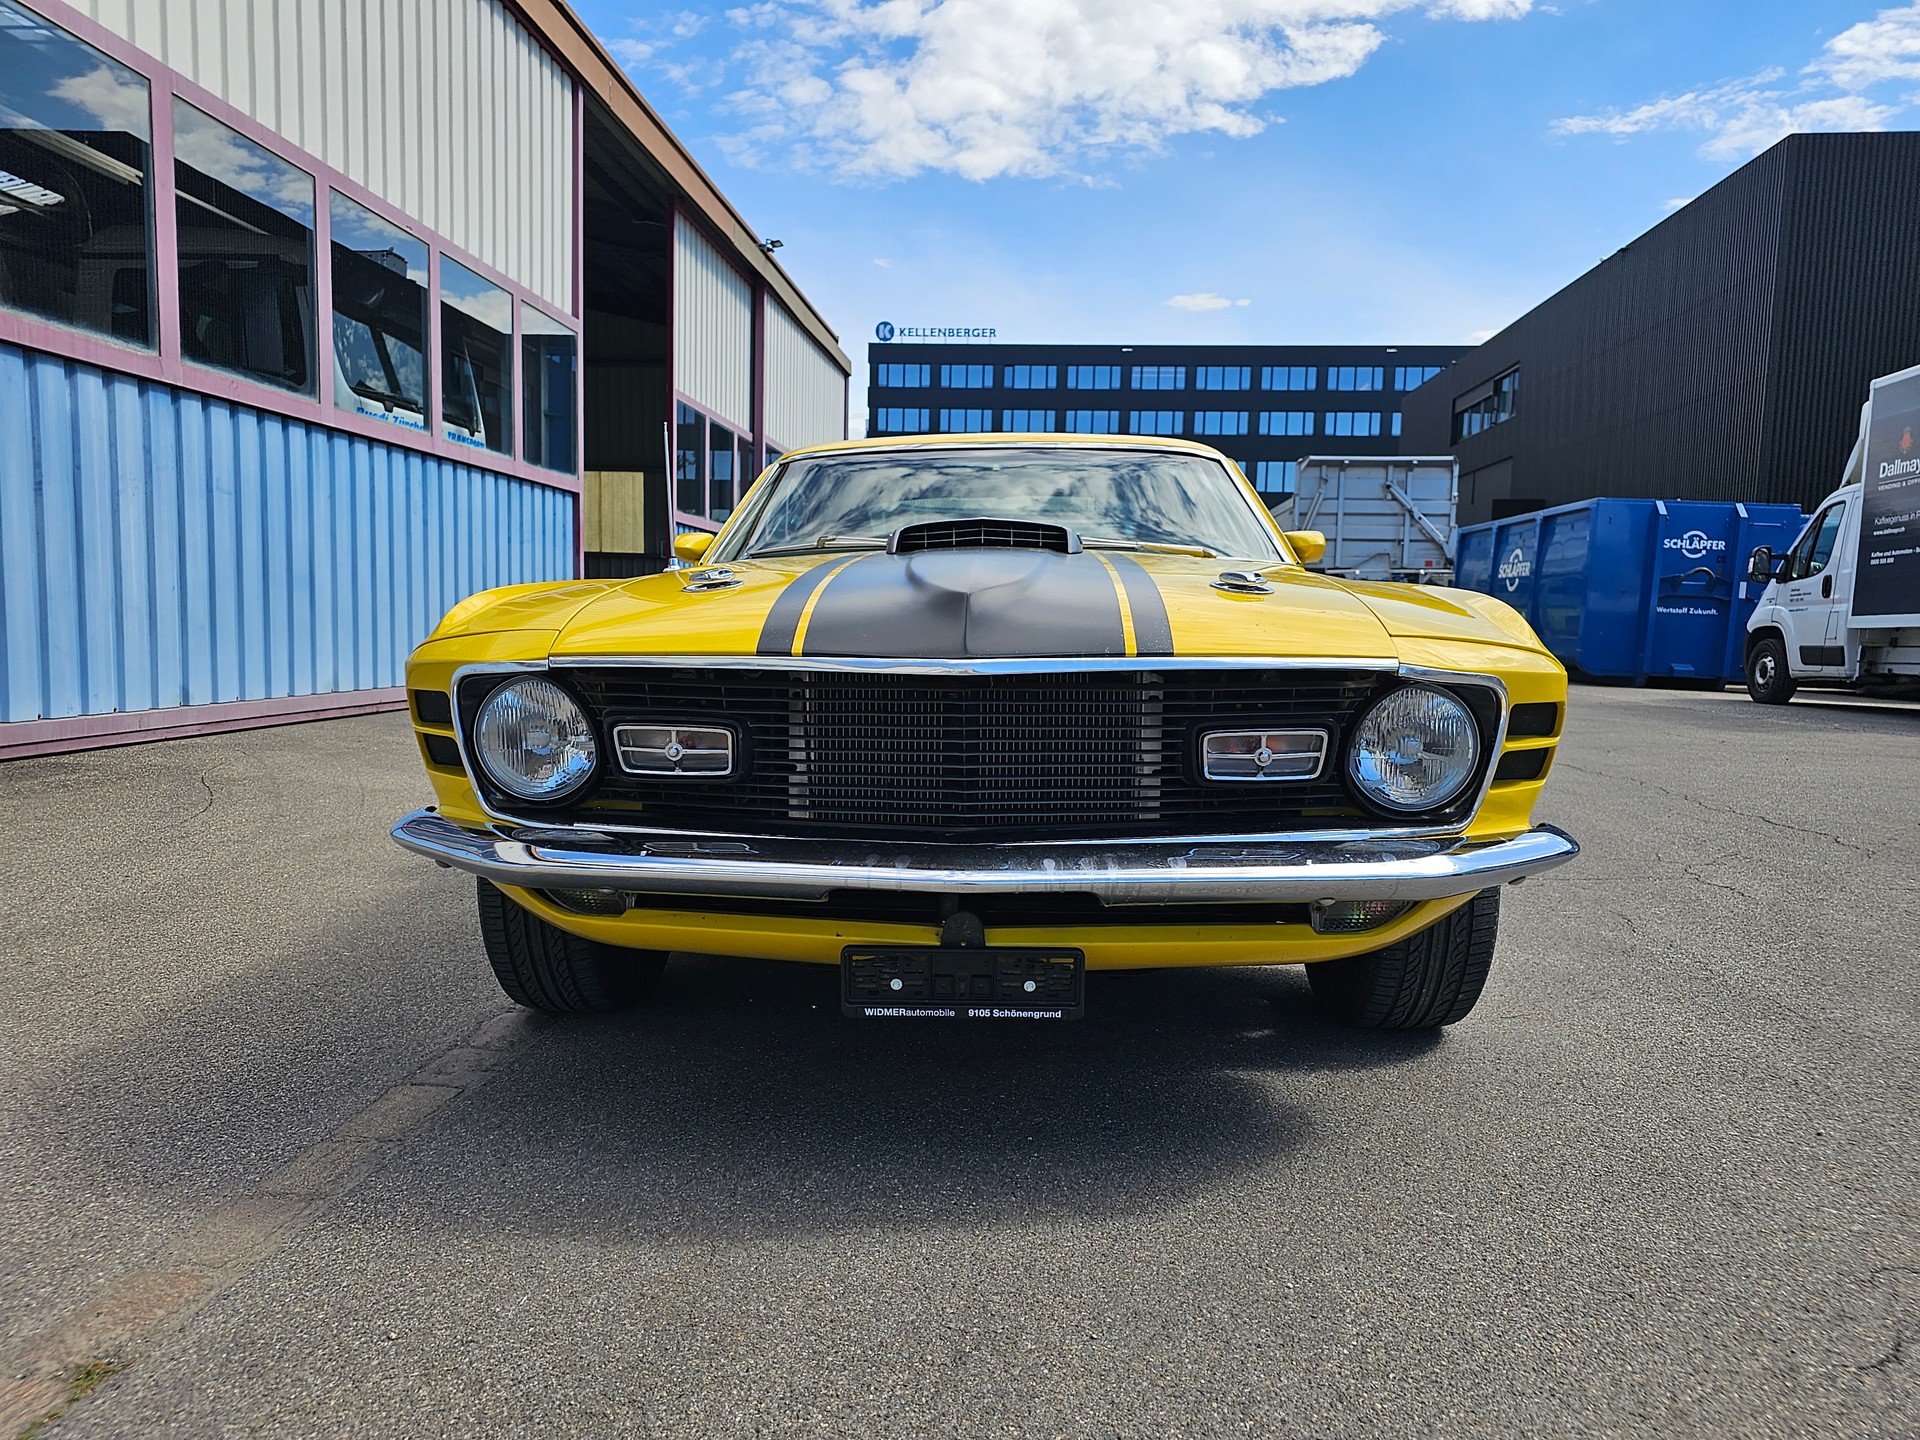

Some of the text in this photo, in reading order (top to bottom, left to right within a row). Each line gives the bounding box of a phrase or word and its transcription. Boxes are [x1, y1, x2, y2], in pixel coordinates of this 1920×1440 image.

[899, 327, 996, 337] KELLENBERGER
[1663, 537, 1726, 550] SCHLÄPFER
[1656, 606, 1687, 614] Wertstoff
[864, 1008, 1062, 1019] WIDMERautomobile 9105 Schönengrund
